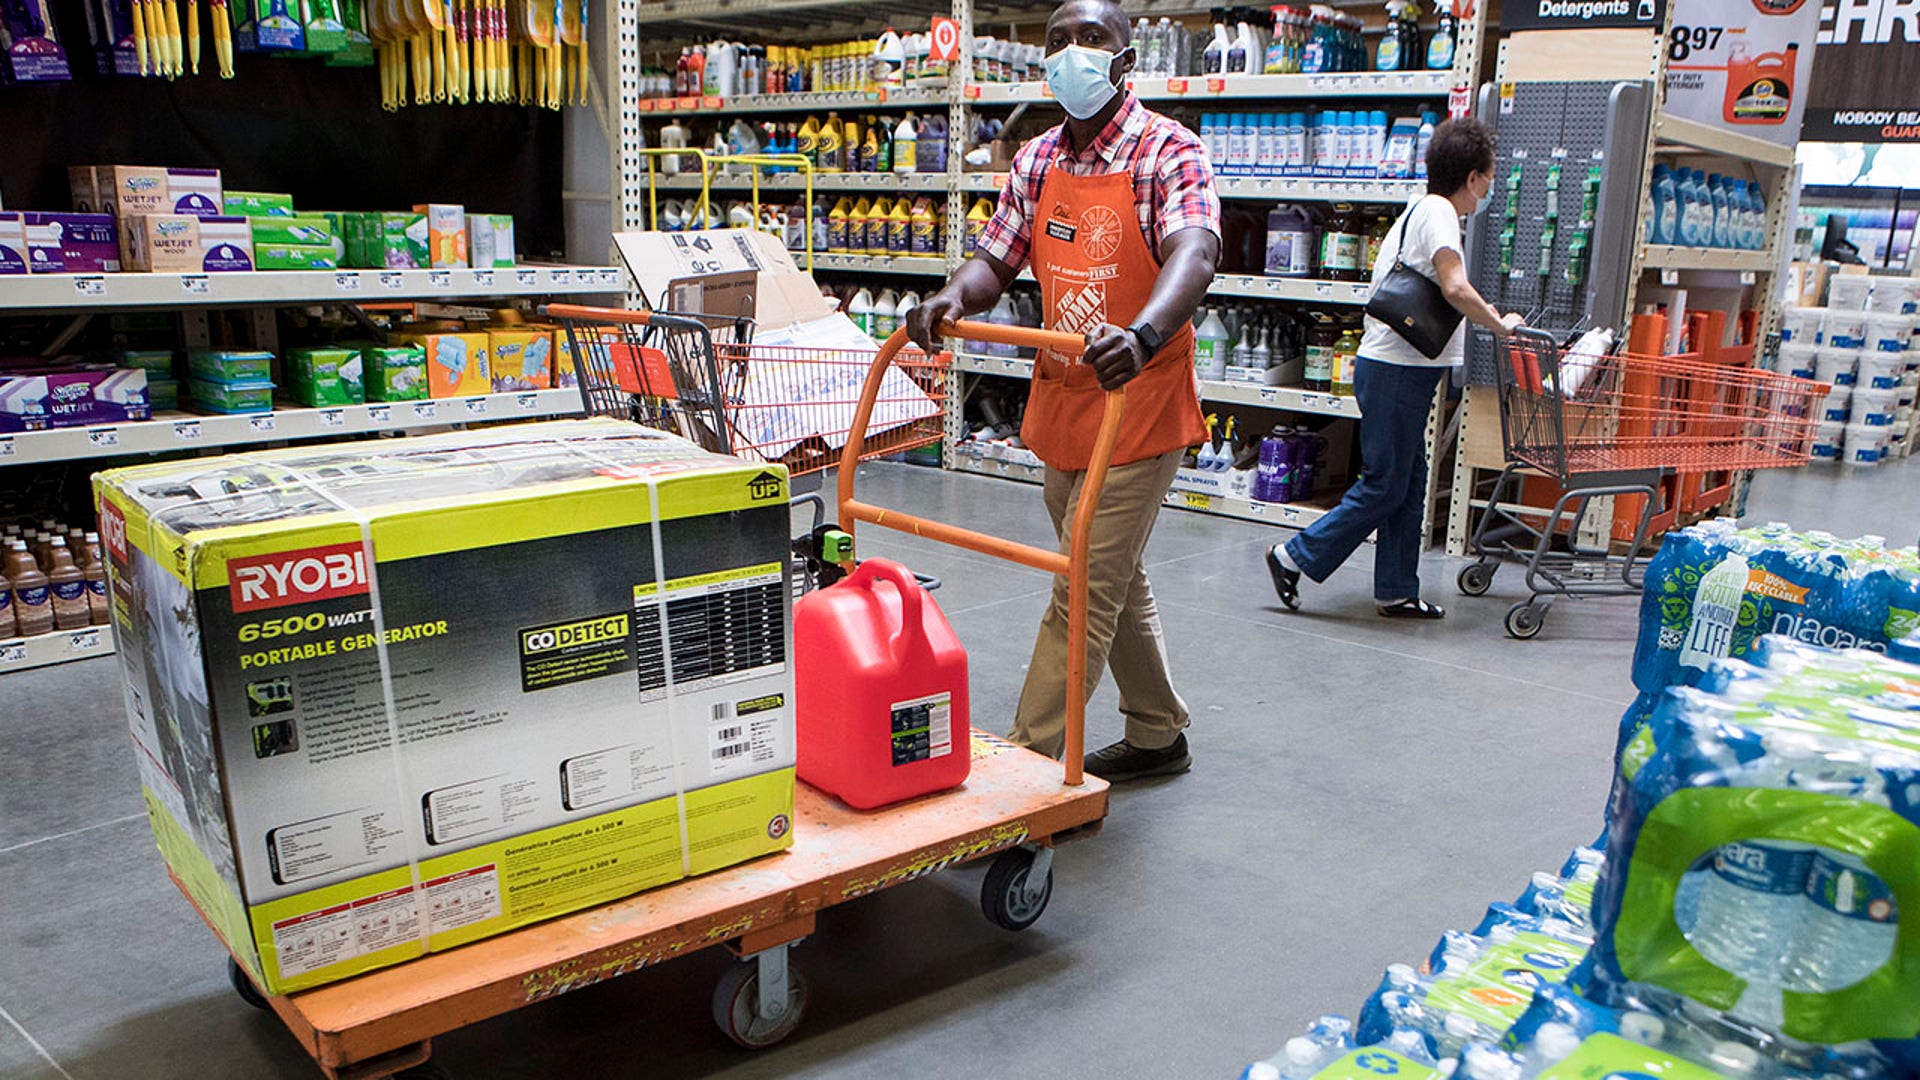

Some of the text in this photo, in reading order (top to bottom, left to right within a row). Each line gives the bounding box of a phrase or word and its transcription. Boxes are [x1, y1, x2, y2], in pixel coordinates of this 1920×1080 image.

[1538, 1, 1629, 20] Detergents
[1682, 73, 1703, 81] DUTY
[1833, 111, 1894, 125] NOBODY
[123, 195, 162, 203] WETJET
[246, 197, 260, 207] XL
[154, 240, 193, 248] WETJET
[290, 250, 304, 259] XL
[1089, 267, 1118, 279] FIRST
[1056, 287, 1077, 313] THE
[52, 403, 94, 414] WETJET
[1192, 477, 1219, 487] SPRAYER
[752, 484, 778, 498] UP
[235, 551, 367, 602] RYOBI
[1764, 574, 1787, 590] 100%
[1748, 581, 1799, 603] RECYCLABLE
[1698, 602, 1734, 627] ANOTHER
[238, 608, 376, 643] 6500 WATT
[527, 618, 625, 650] CO DETECT
[1771, 612, 1888, 656] niagara
[240, 639, 337, 670] PORTABLE
[341, 620, 448, 652] GENERATOR
[774, 819, 783, 833] 3
